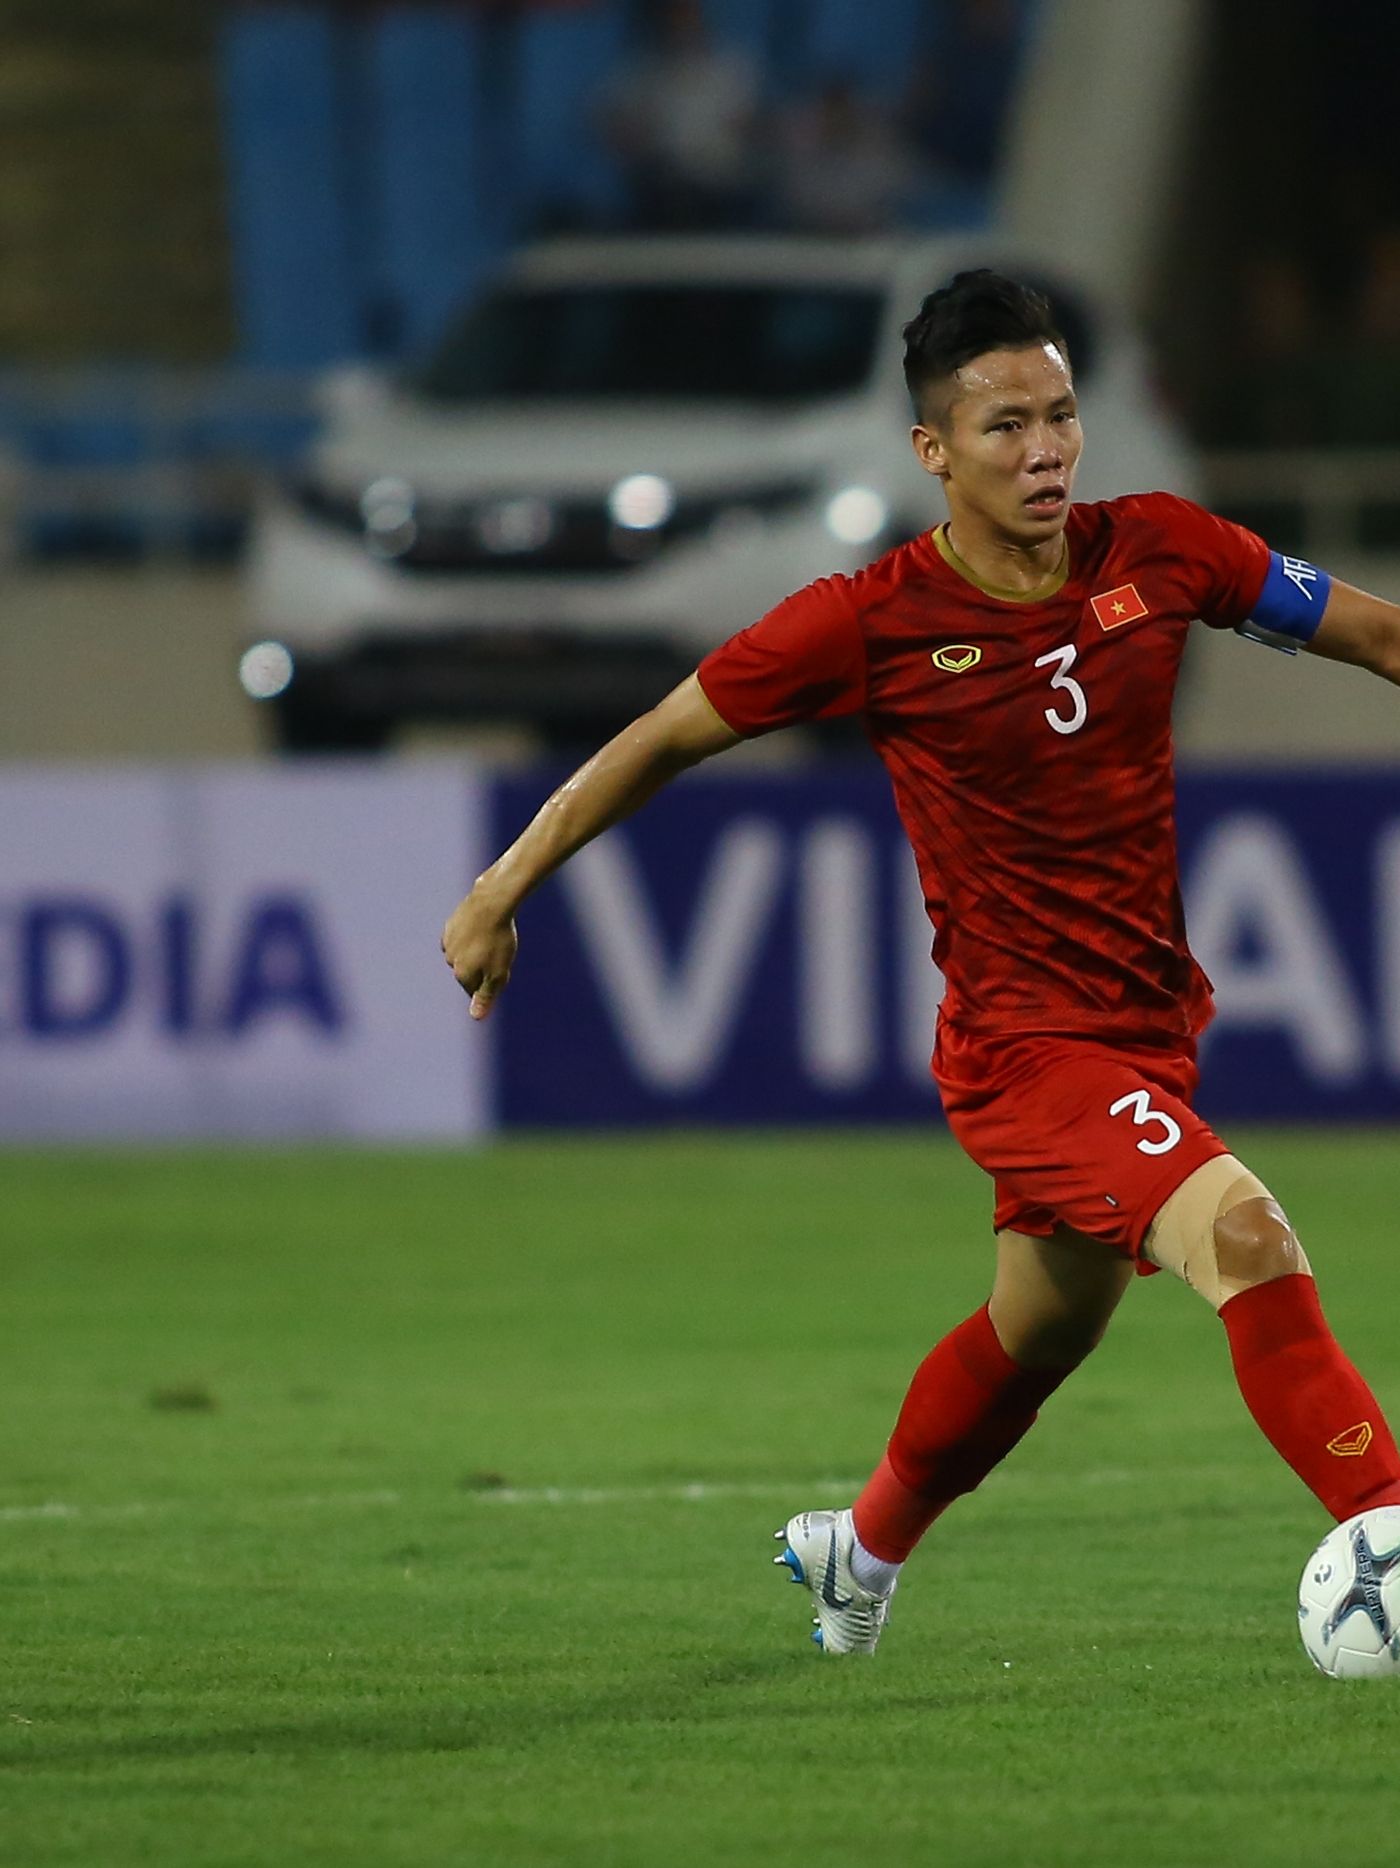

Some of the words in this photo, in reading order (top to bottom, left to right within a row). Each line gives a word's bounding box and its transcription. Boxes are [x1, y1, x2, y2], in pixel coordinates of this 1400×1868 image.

[1283, 556, 1317, 600] AF
[1035, 643, 1087, 734] 3
[0, 893, 348, 1038] DIA
[1109, 1089, 1181, 1155] 3
